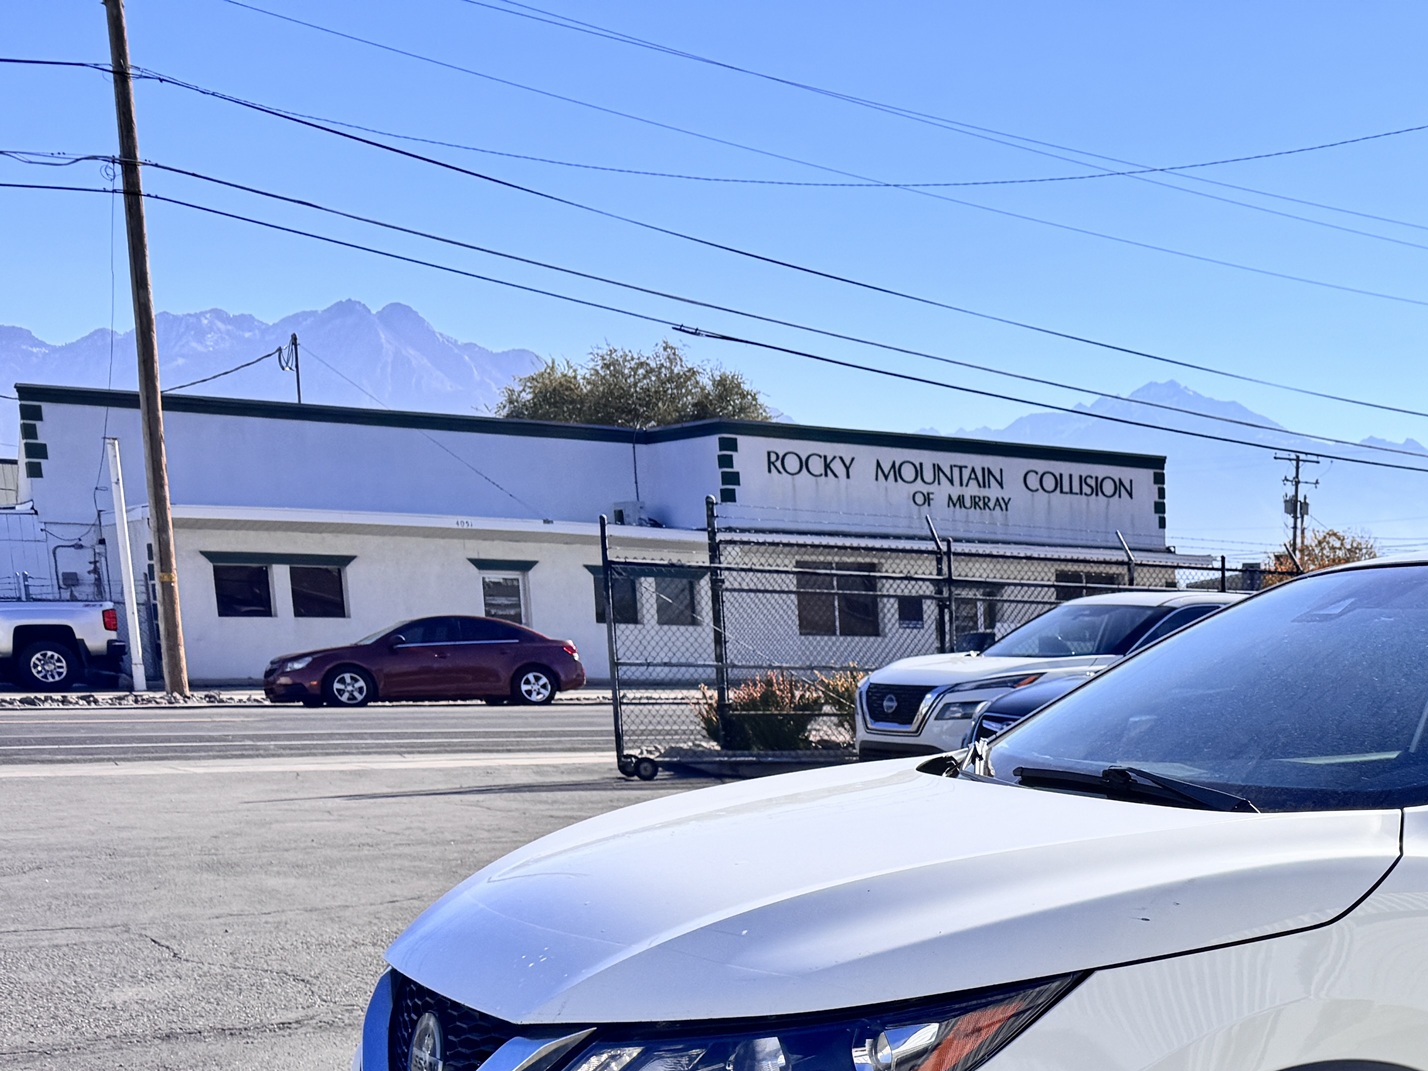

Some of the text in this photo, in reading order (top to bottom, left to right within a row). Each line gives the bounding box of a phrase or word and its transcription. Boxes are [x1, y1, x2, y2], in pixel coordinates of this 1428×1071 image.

[766, 450, 1134, 500] ROCKY MOUNTAIN COLLISION
[912, 490, 1011, 513] OF MURRAY
